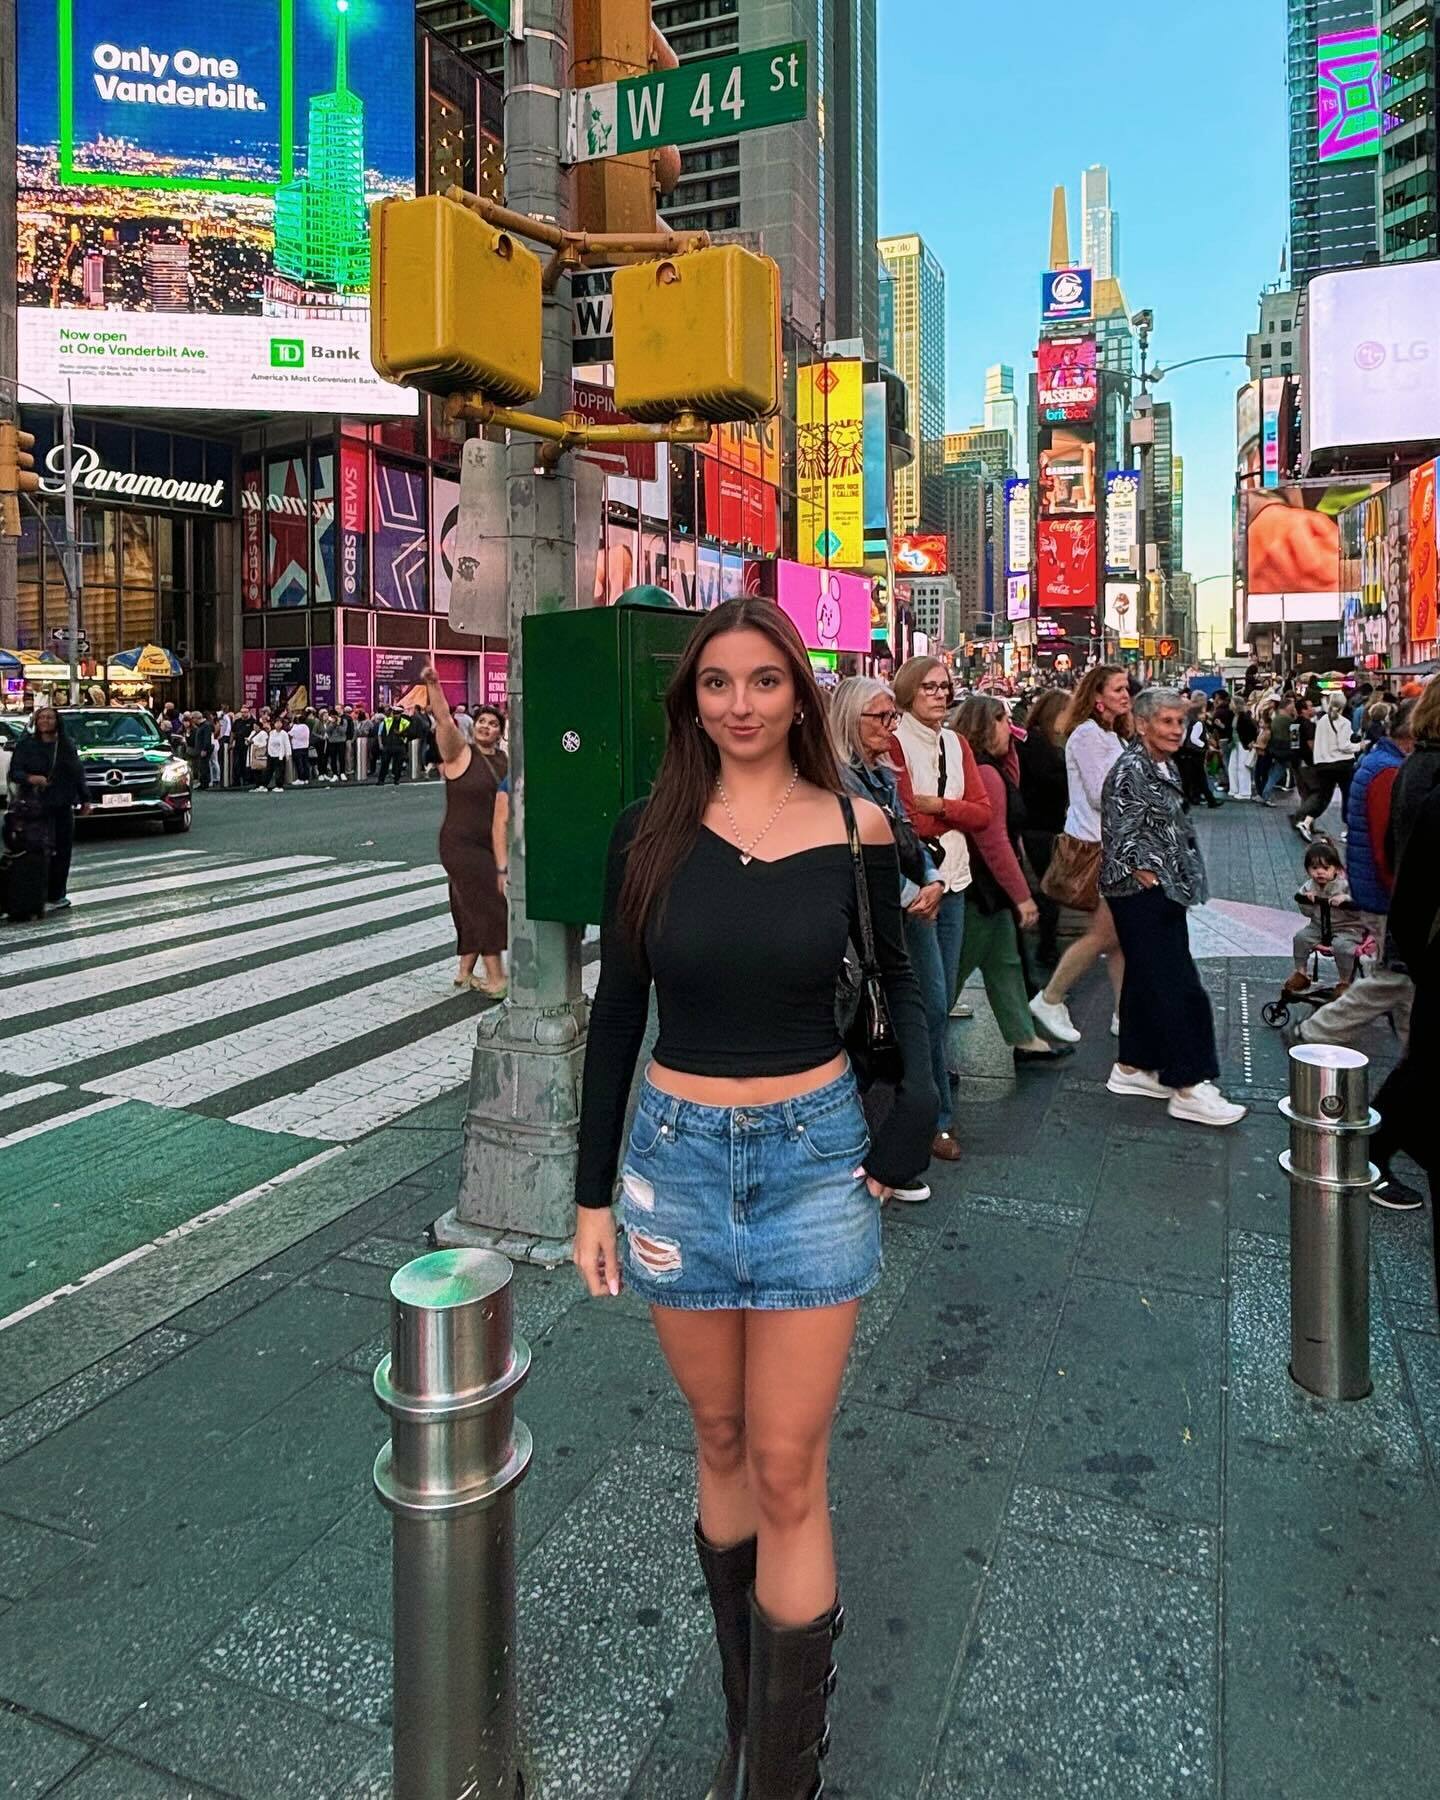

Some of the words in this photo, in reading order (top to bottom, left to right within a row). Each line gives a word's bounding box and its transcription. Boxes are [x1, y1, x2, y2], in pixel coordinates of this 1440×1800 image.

[93, 43, 169, 77] Only
[173, 51, 239, 78] One
[93, 74, 267, 111] Vanderbilt.
[627, 82, 665, 141] W
[689, 65, 745, 127] 44
[769, 53, 799, 92] St
[59, 328, 90, 340] Now
[94, 332, 127, 343] open
[59, 343, 73, 354] at
[77, 343, 105, 355] One
[108, 344, 178, 357] Vanderbilt
[180, 347, 209, 359] Ave.
[273, 344, 301, 362] TD
[311, 346, 360, 360] Bank
[1392, 340, 1430, 362] LG
[250, 373, 289, 382] America's
[290, 375, 311, 383] Most
[312, 375, 357, 384] Convenient
[358, 377, 378, 385] Bank
[574, 390, 617, 413] TOPPIN
[1046, 408, 1089, 420] britbox
[38, 443, 225, 508] Paramount
[344, 466, 358, 532] NEWS
[249, 544, 258, 583] CBS
[344, 535, 357, 577] CBS
